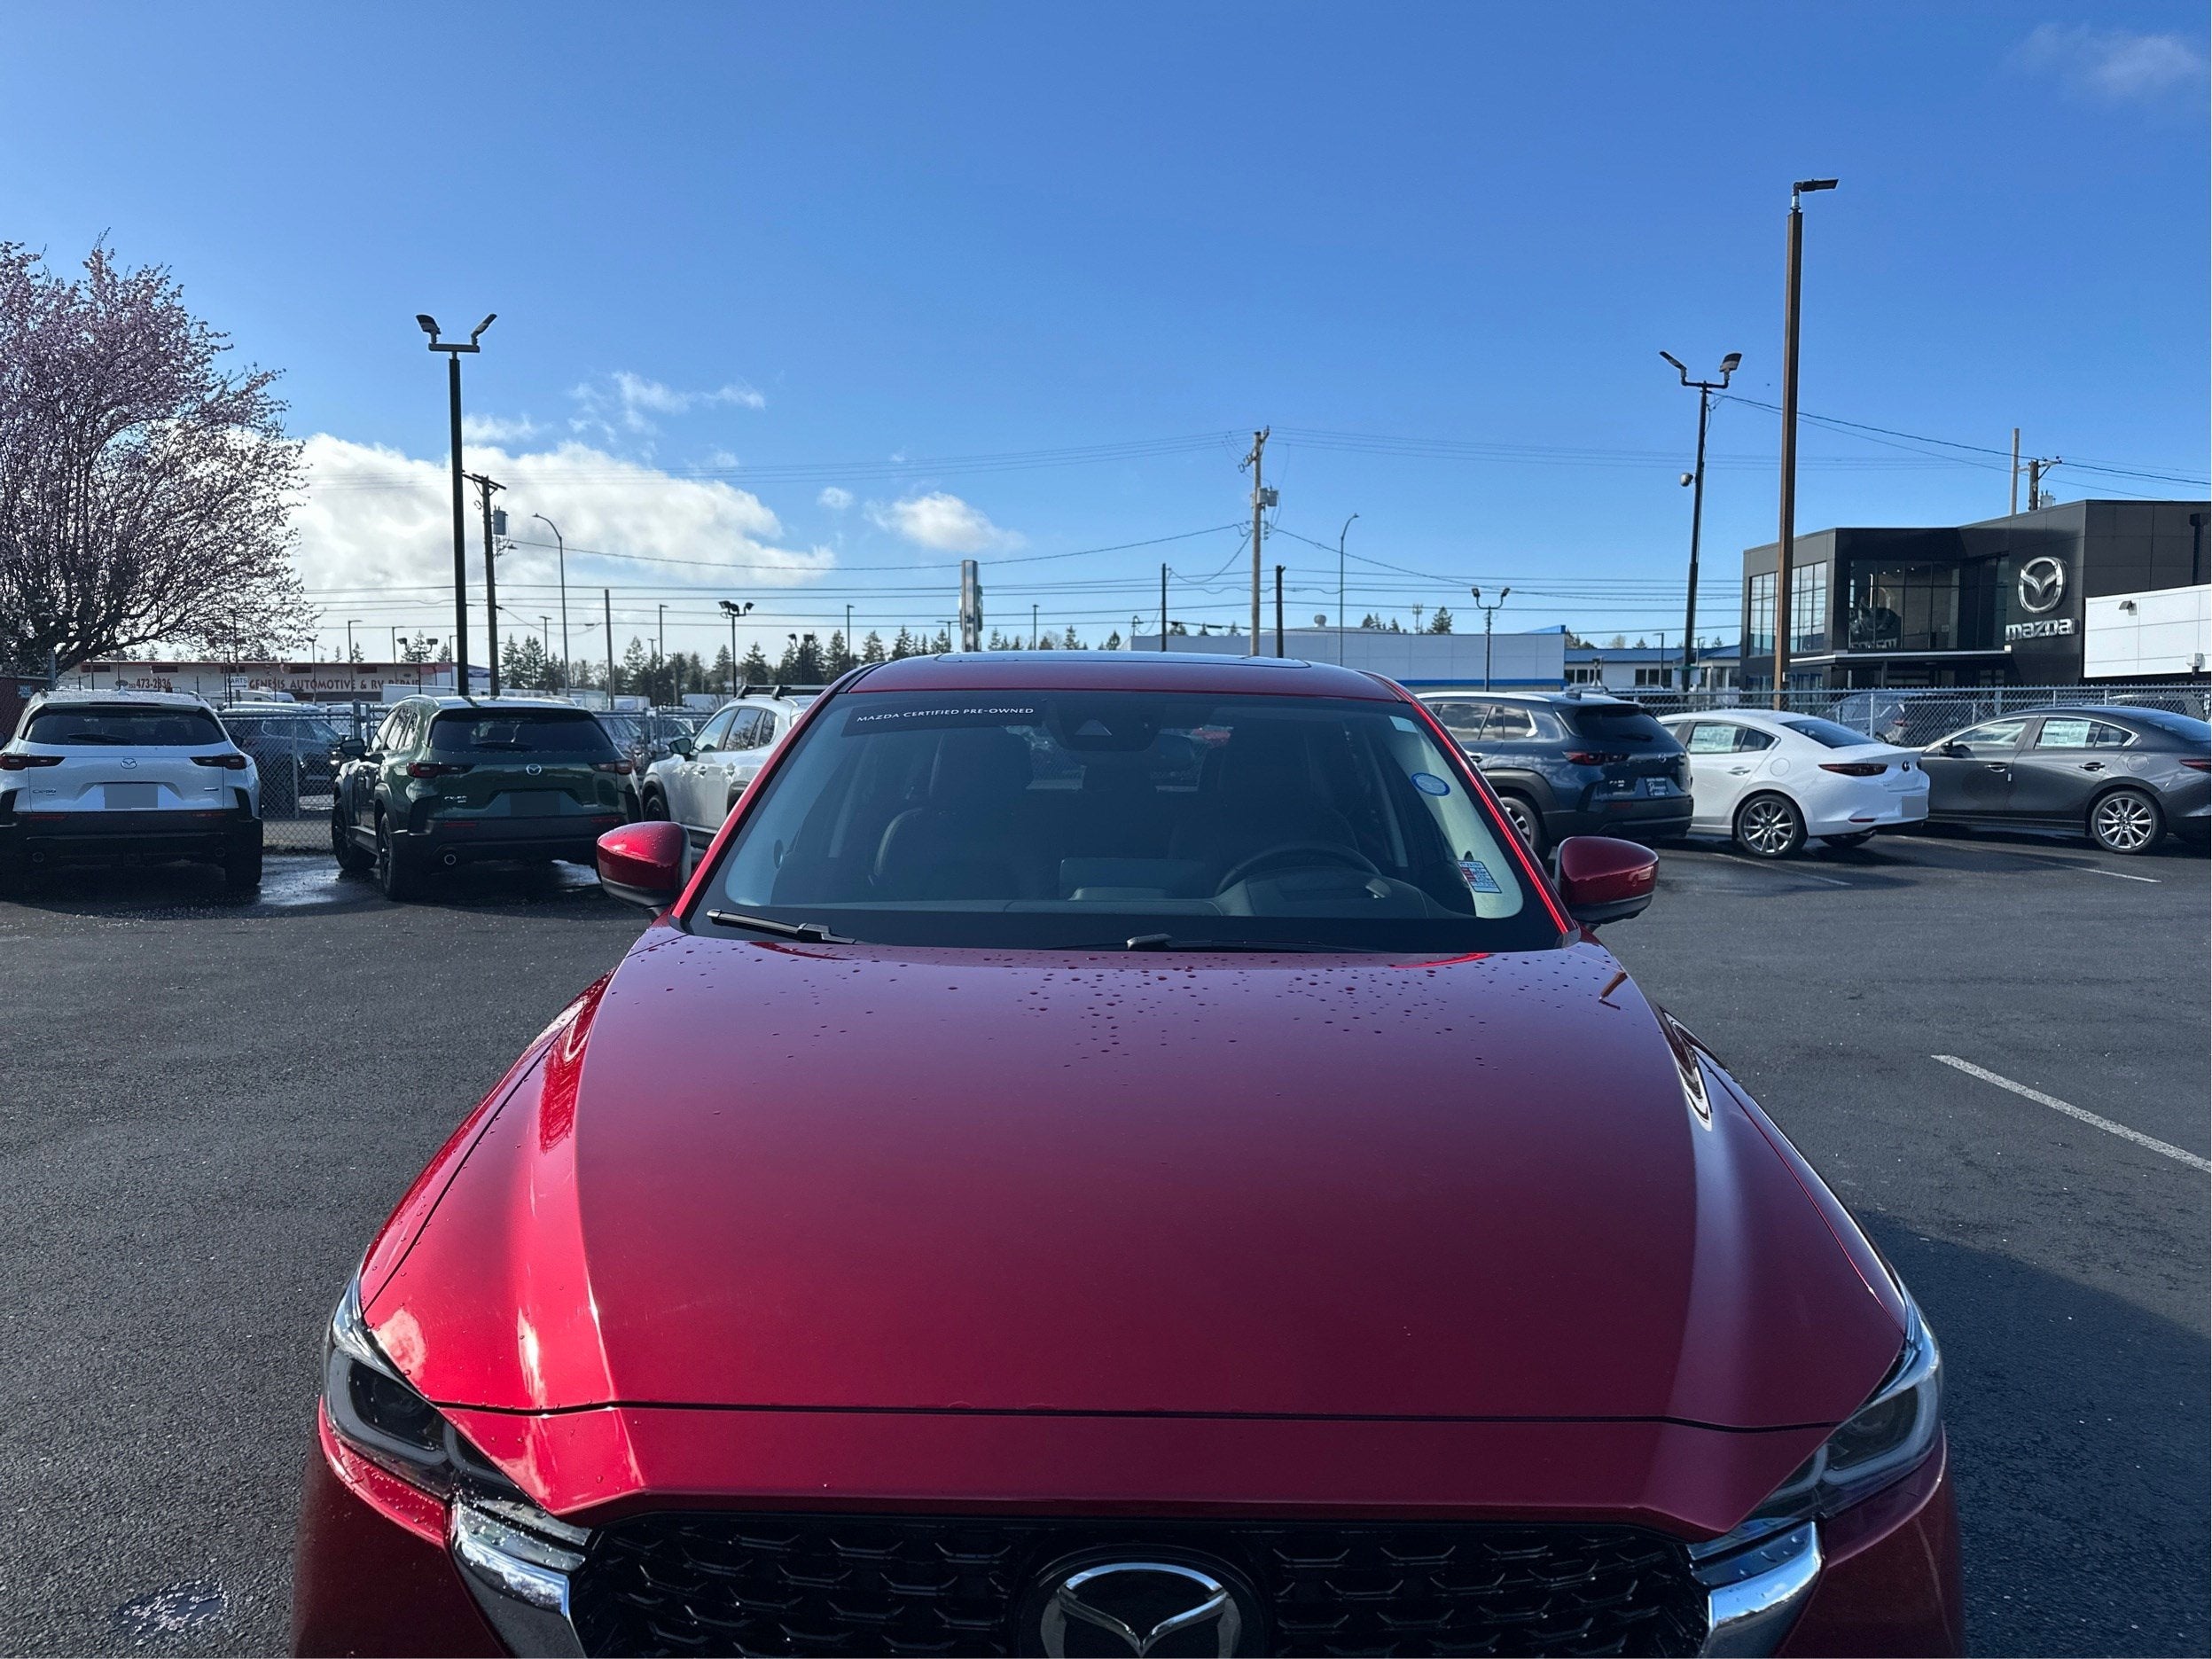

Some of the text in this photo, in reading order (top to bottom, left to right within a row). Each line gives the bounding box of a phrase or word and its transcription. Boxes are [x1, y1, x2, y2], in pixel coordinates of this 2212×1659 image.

[2005, 619, 2074, 641] mazda
[249, 679, 285, 689] GENESIS
[290, 679, 356, 690] AUTOMOTIVE
[360, 679, 367, 689] &
[371, 679, 384, 689] RV
[856, 713, 899, 722] MAZDA
